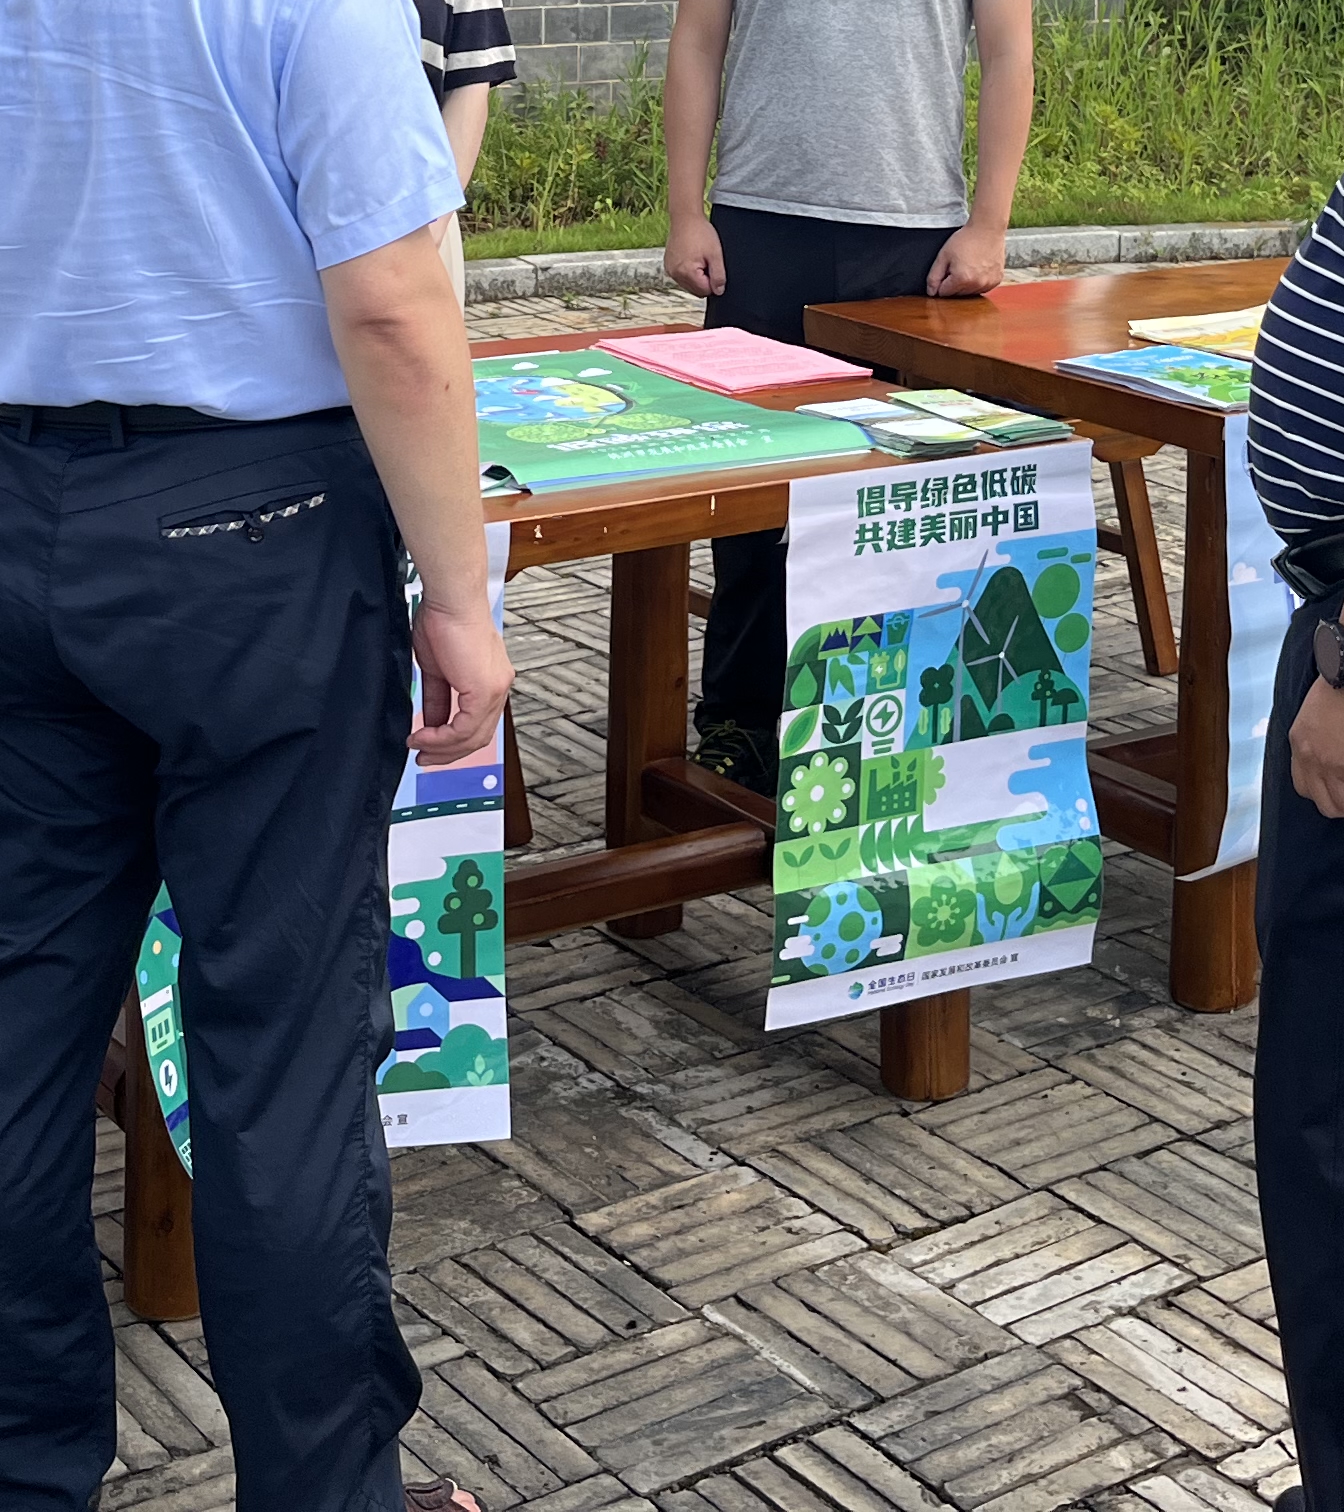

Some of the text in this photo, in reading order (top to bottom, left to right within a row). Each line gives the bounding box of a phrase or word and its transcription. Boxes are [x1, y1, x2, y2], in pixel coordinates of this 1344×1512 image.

[856, 463, 1038, 519] 倡导绿色低碳
[854, 500, 1040, 556] 共建美丽中国
[869, 972, 915, 989] 全国生态日
[922, 955, 1007, 980] 国家发展和改革委员会
[397, 1113, 409, 1126] 宣
